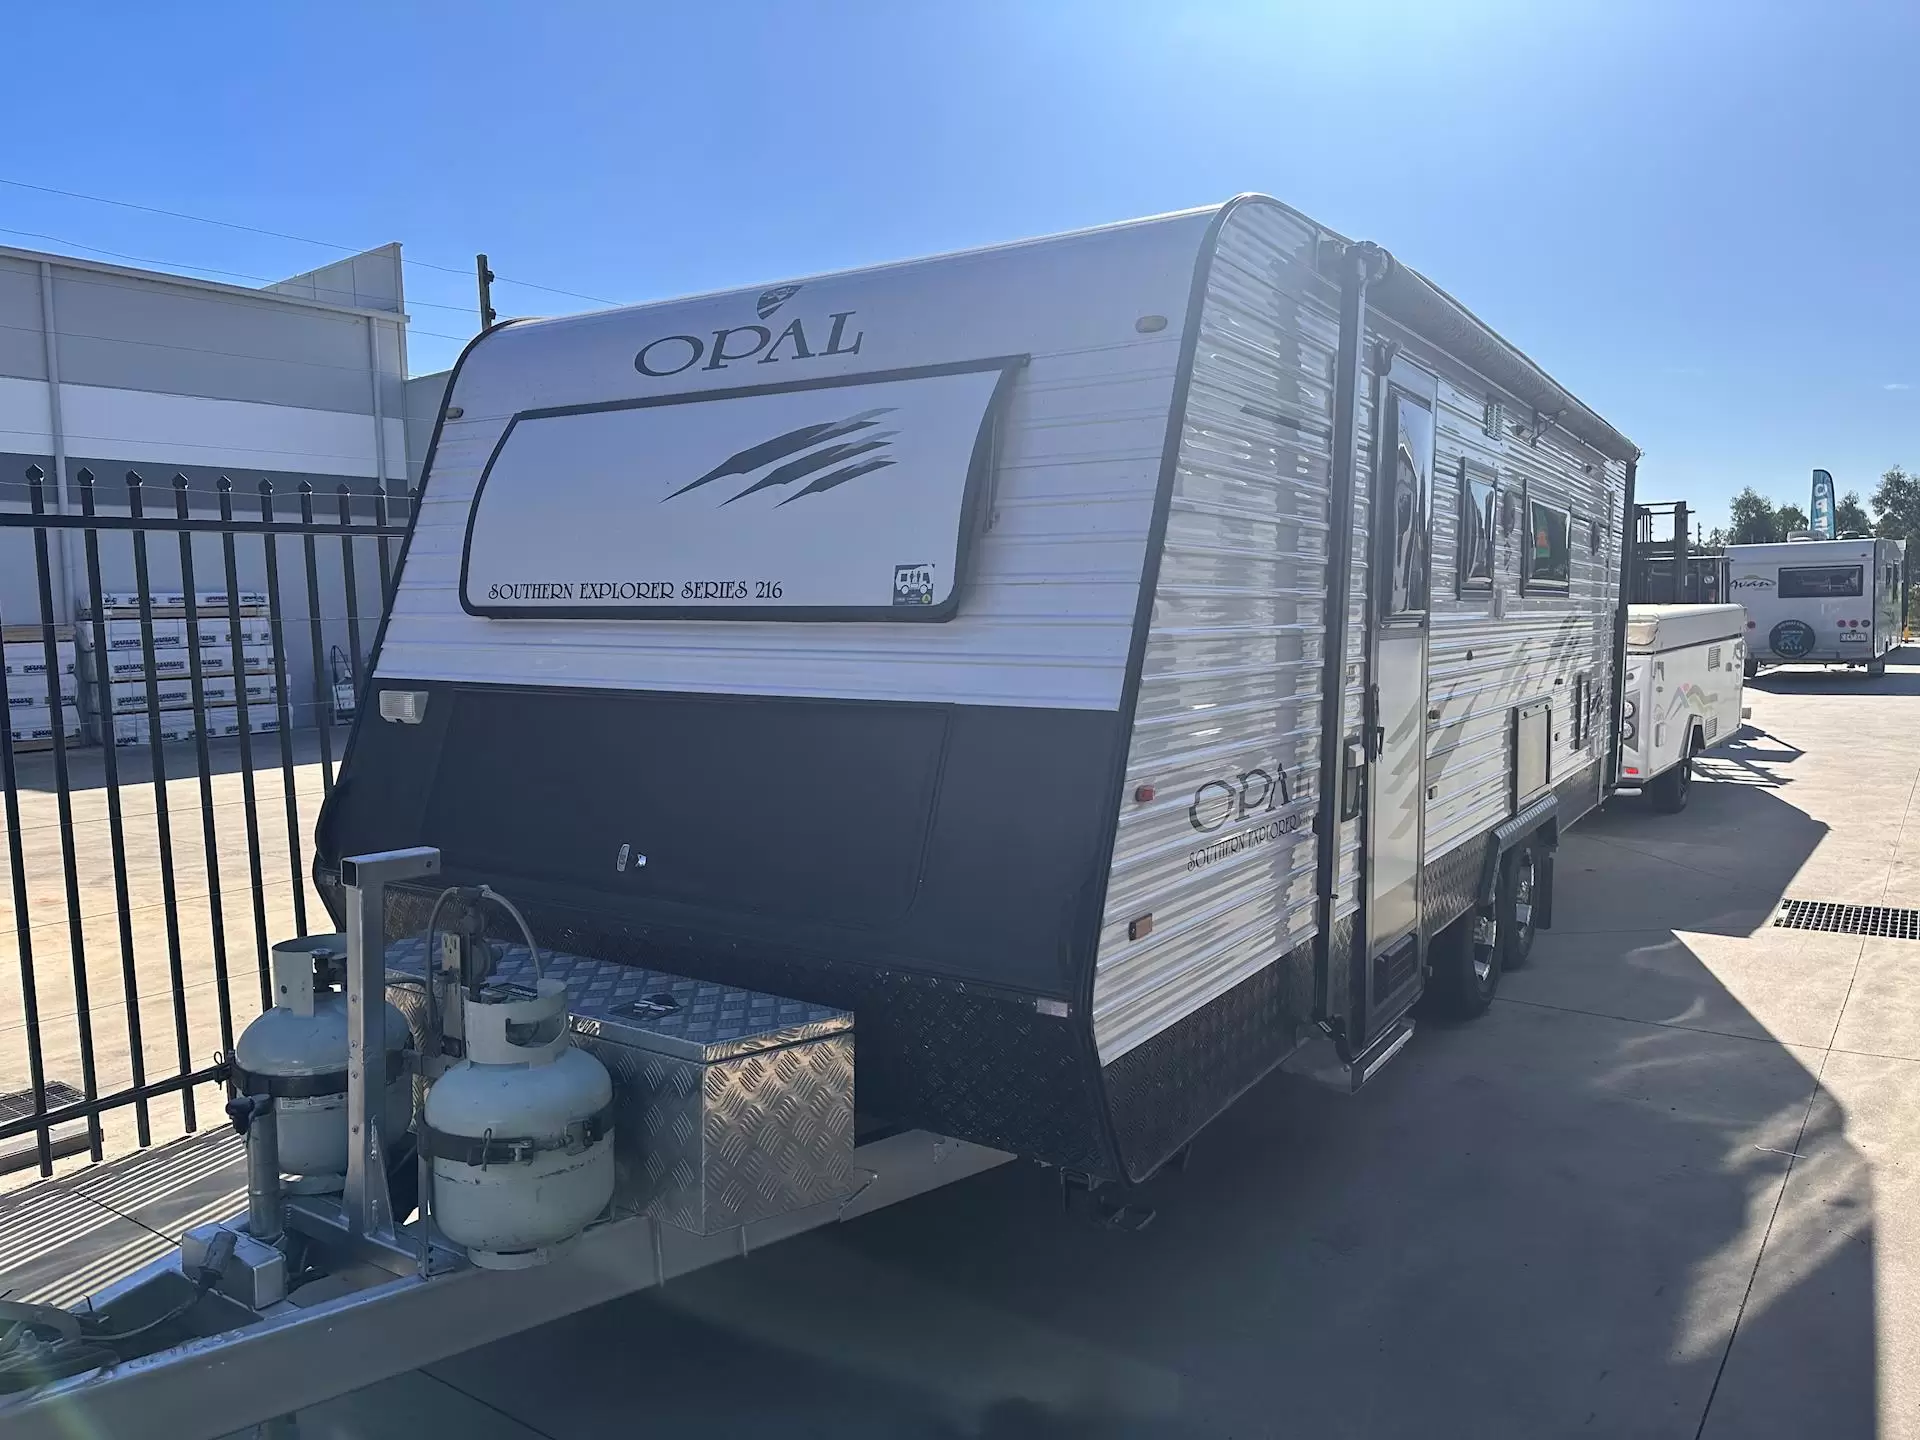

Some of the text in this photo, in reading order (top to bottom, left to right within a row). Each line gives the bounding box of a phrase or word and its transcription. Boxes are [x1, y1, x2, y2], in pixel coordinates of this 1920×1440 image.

[634, 311, 863, 377] OPAL
[488, 580, 783, 600] SOUTHERN EXPLORER SERIES 216
[1187, 834, 1246, 872] SOUTHERN
